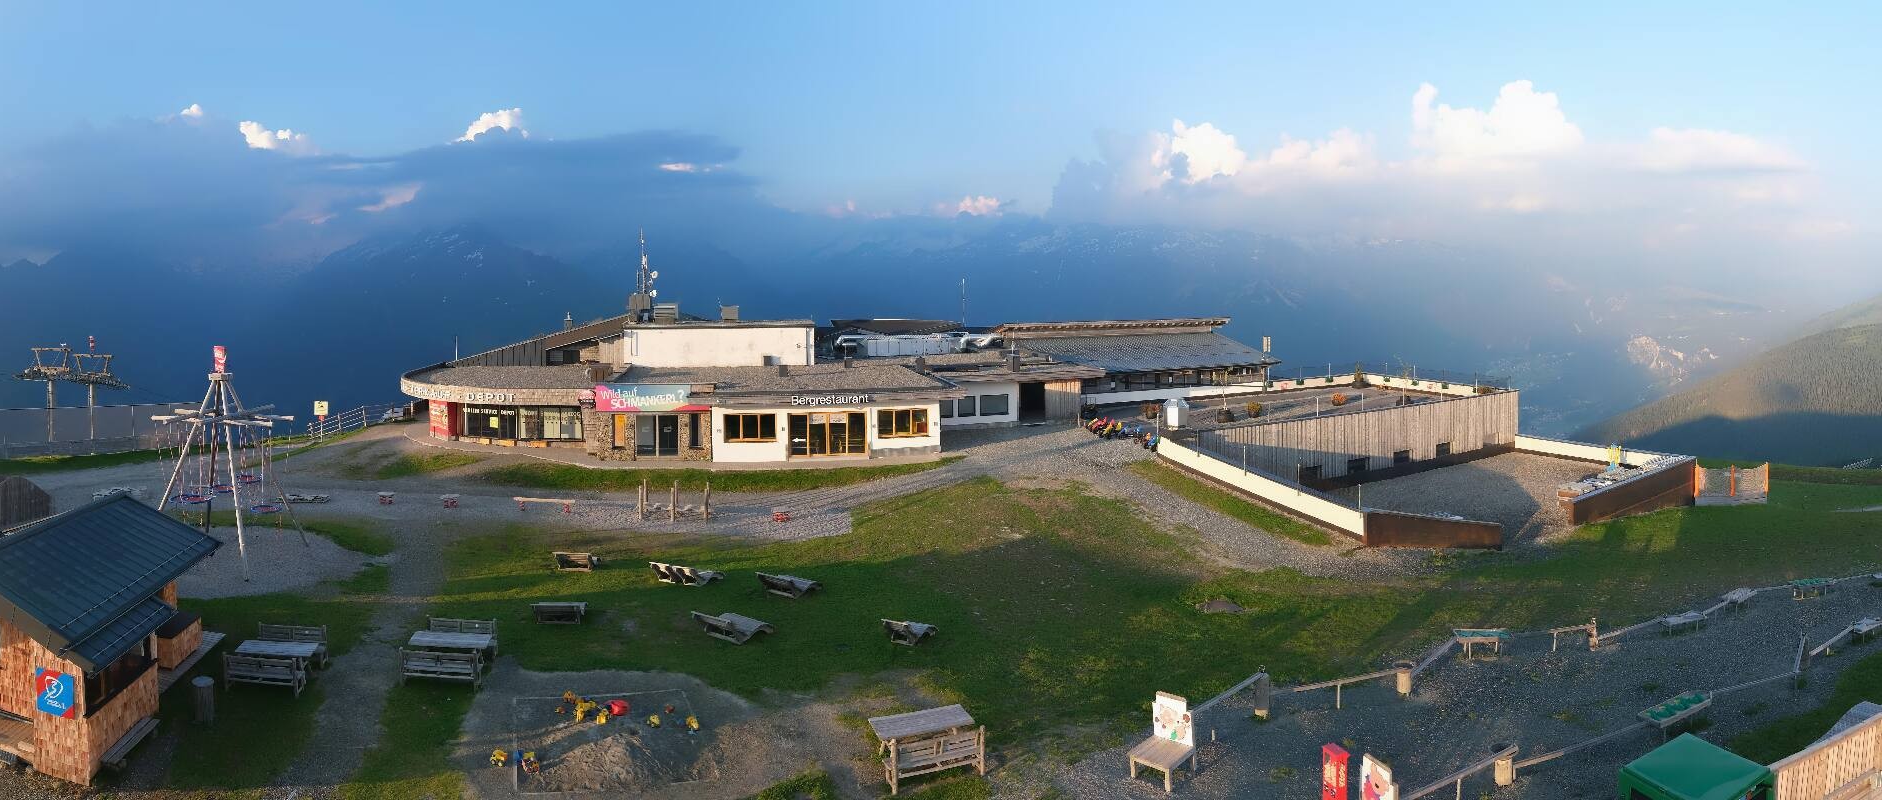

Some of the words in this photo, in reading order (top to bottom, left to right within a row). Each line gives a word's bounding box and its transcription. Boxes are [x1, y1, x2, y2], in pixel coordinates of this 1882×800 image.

[467, 392, 516, 402] DEPOT
[600, 389, 620, 400] Wild
[622, 387, 638, 398] auf
[791, 394, 869, 406] Bergrestaurant
